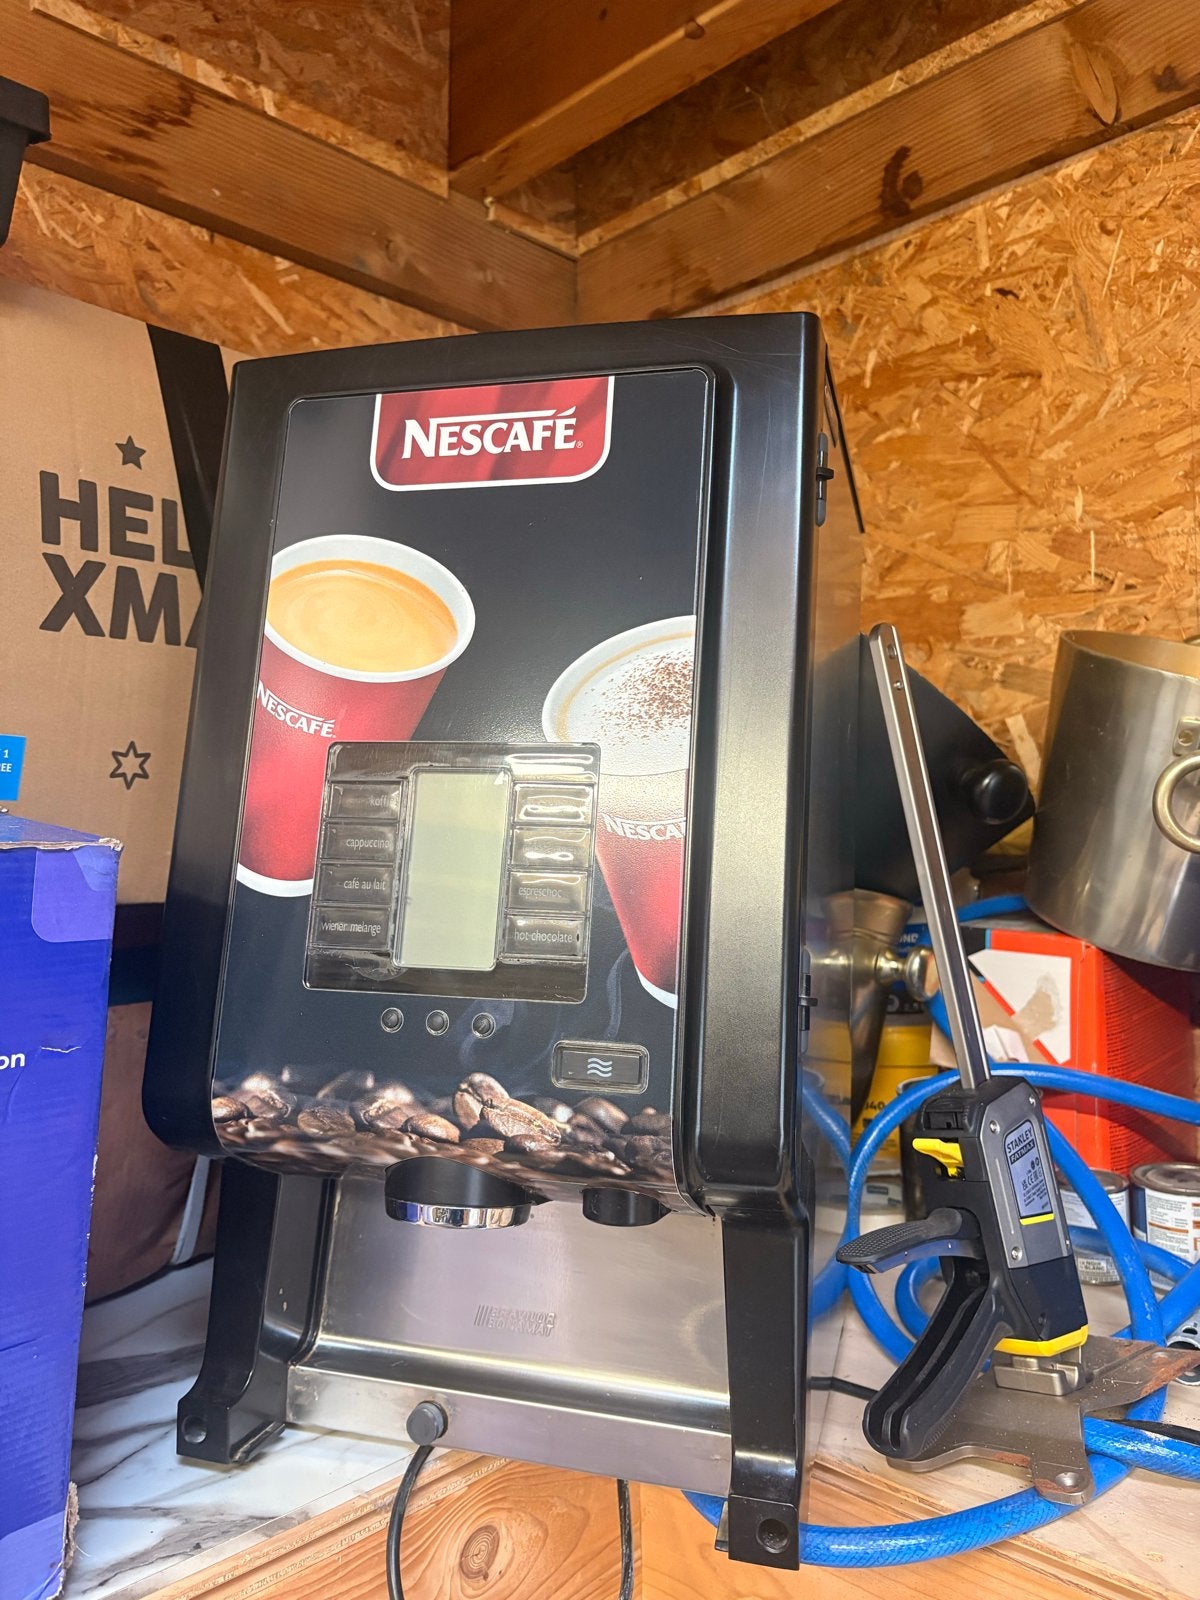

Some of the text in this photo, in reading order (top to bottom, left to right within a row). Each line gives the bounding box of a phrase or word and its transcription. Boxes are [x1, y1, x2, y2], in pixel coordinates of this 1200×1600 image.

[401, 406, 577, 459] NESCAFÉ
[39, 552, 204, 648] XM
[346, 839, 390, 851] cappuccino
[344, 877, 385, 890] café au lait
[321, 920, 381, 937] wiener melange
[514, 928, 573, 943] hot chocolate
[1006, 1127, 1033, 1153] STANLEY
[1010, 1140, 1035, 1164] FATMAX
